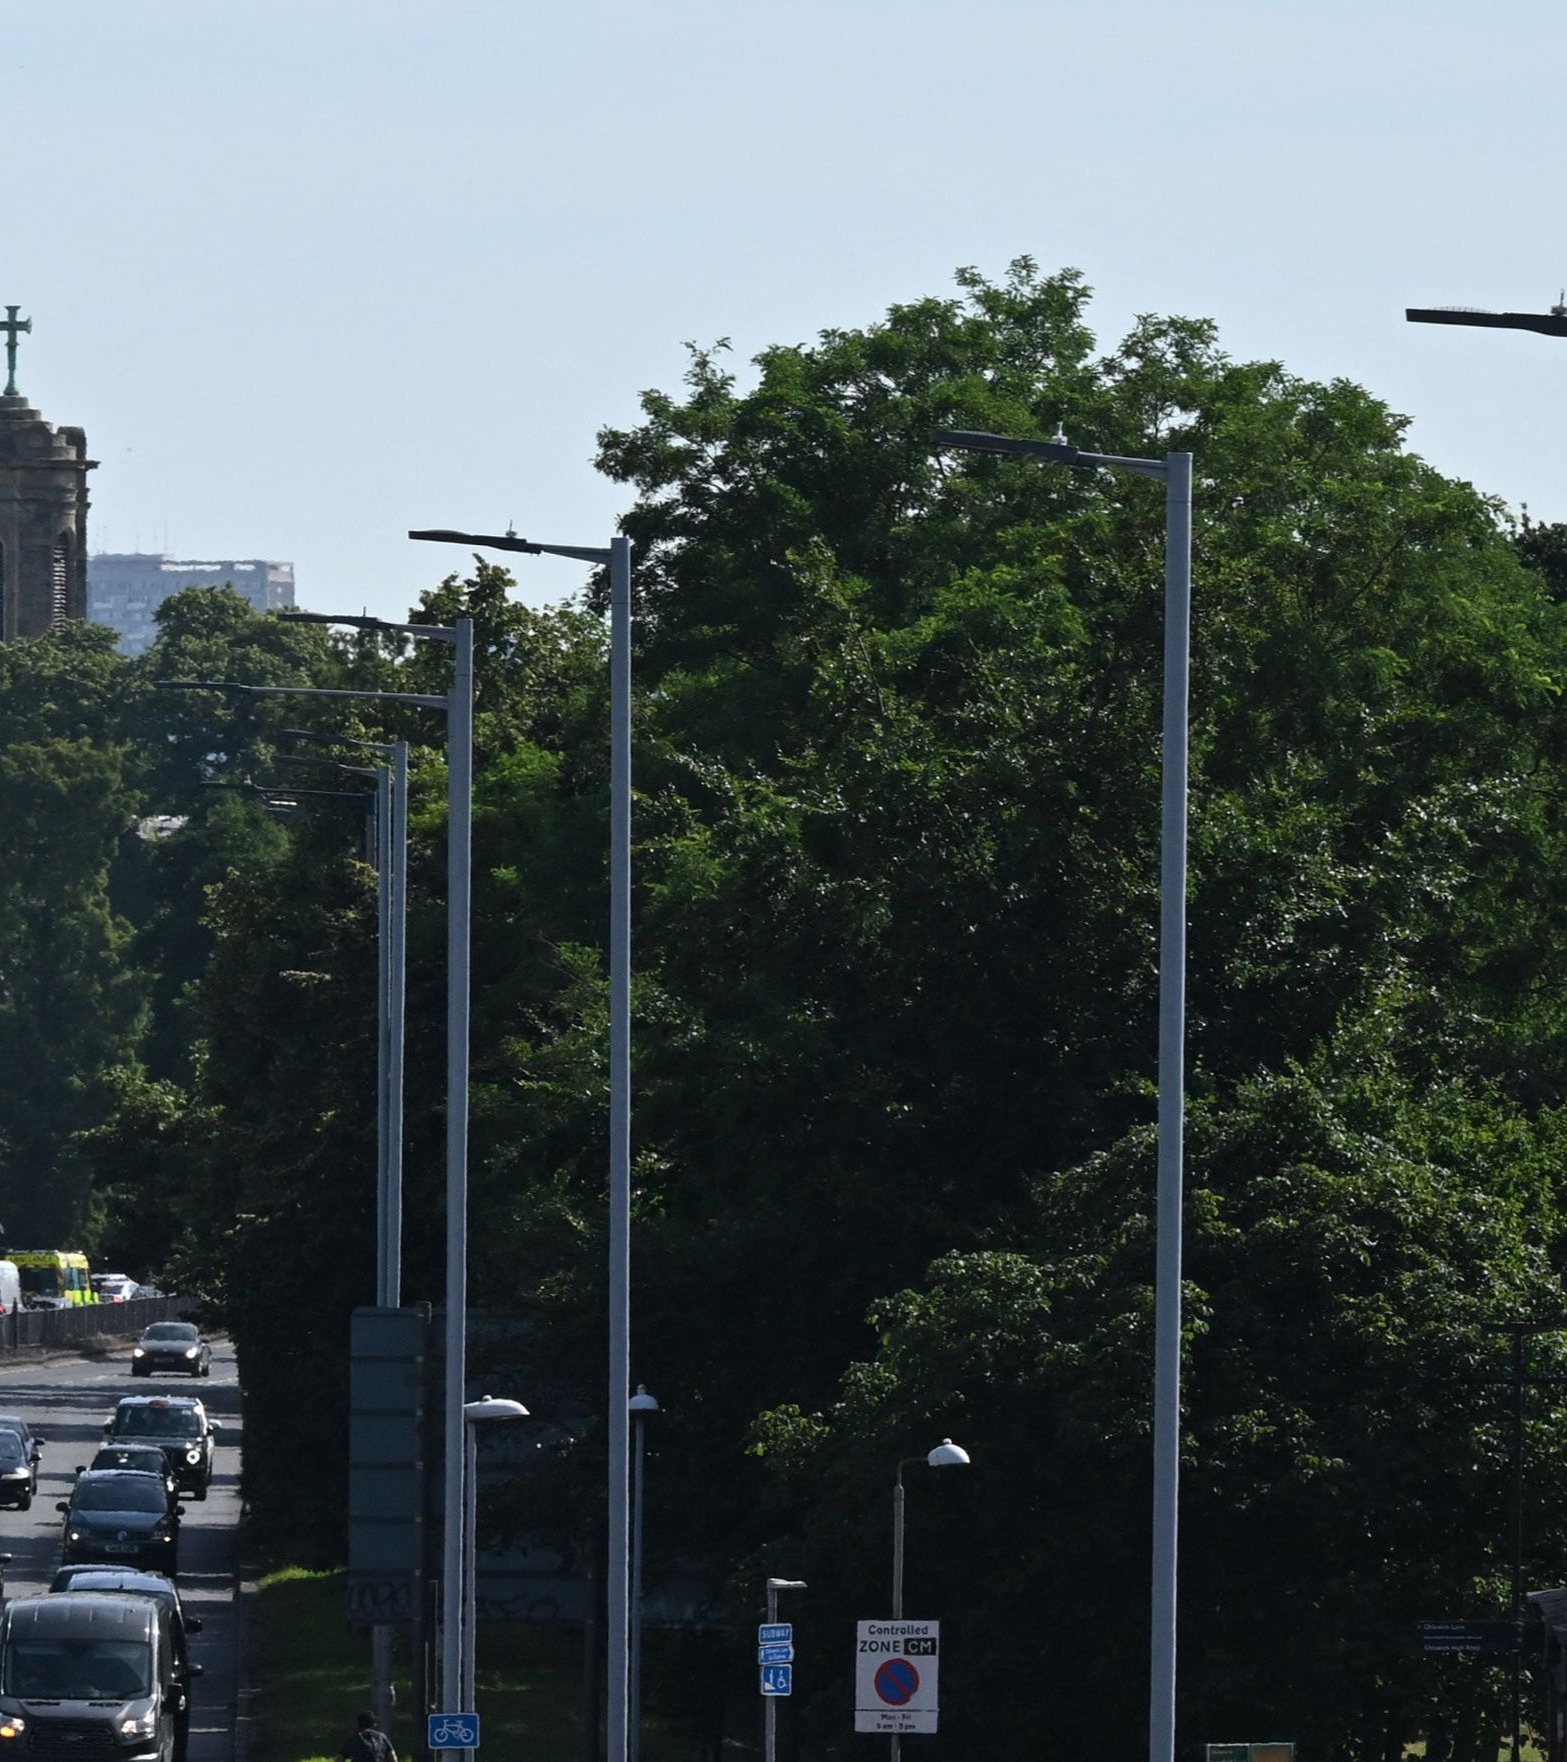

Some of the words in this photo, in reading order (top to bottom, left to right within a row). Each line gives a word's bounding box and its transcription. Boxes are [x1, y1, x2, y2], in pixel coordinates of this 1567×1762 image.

[869, 1625, 929, 1635] Controlled
[860, 1640, 901, 1653] ZONE
[908, 1641, 933, 1653] CM
